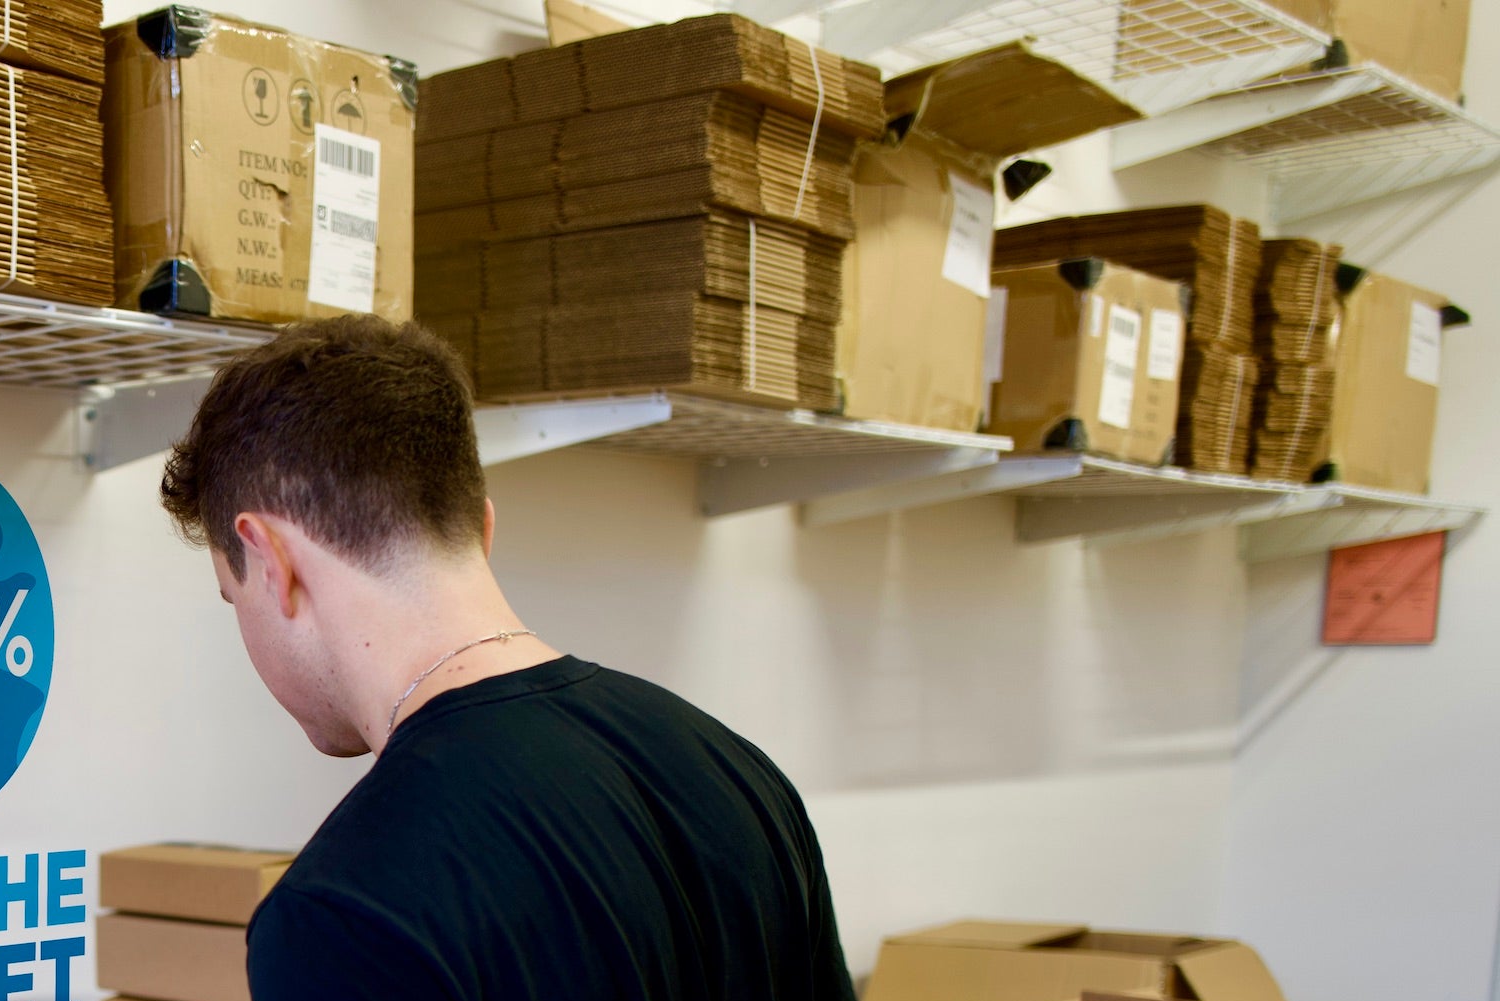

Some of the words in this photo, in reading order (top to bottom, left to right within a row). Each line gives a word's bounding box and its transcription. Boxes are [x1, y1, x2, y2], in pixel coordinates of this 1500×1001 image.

[239, 149, 277, 173] ITEM
[281, 158, 308, 178] NO:
[238, 179, 271, 201] QTY:
[236, 267, 283, 289] MEAS:
